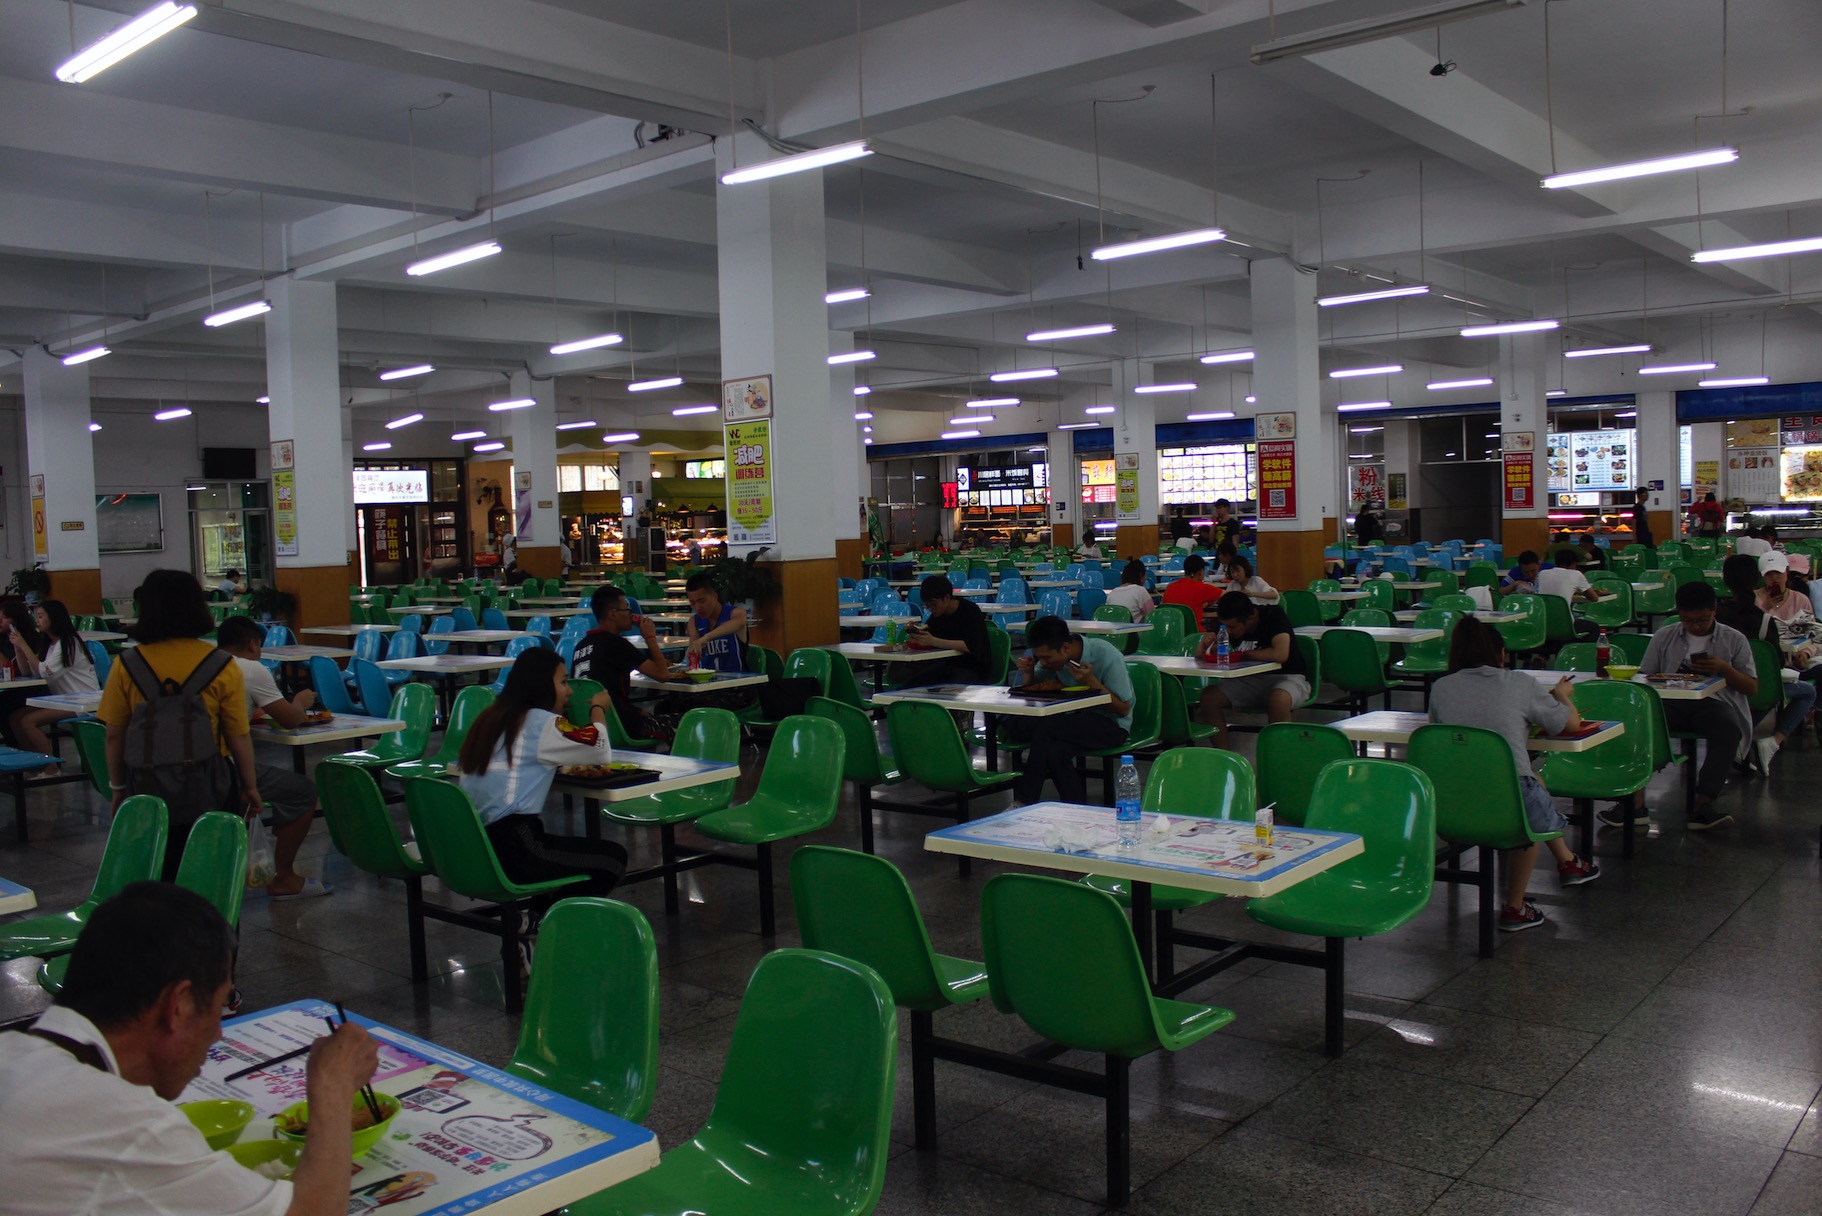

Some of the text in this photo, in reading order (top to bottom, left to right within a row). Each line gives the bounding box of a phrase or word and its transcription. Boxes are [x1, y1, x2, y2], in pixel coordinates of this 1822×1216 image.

[733, 443, 765, 466] 减肥
[1262, 458, 1292, 470] 学软件
[736, 467, 764, 480] 训练营
[1359, 466, 1378, 487] 粉
[1353, 487, 1385, 501] 米线
[386, 518, 399, 560] 禁止带出
